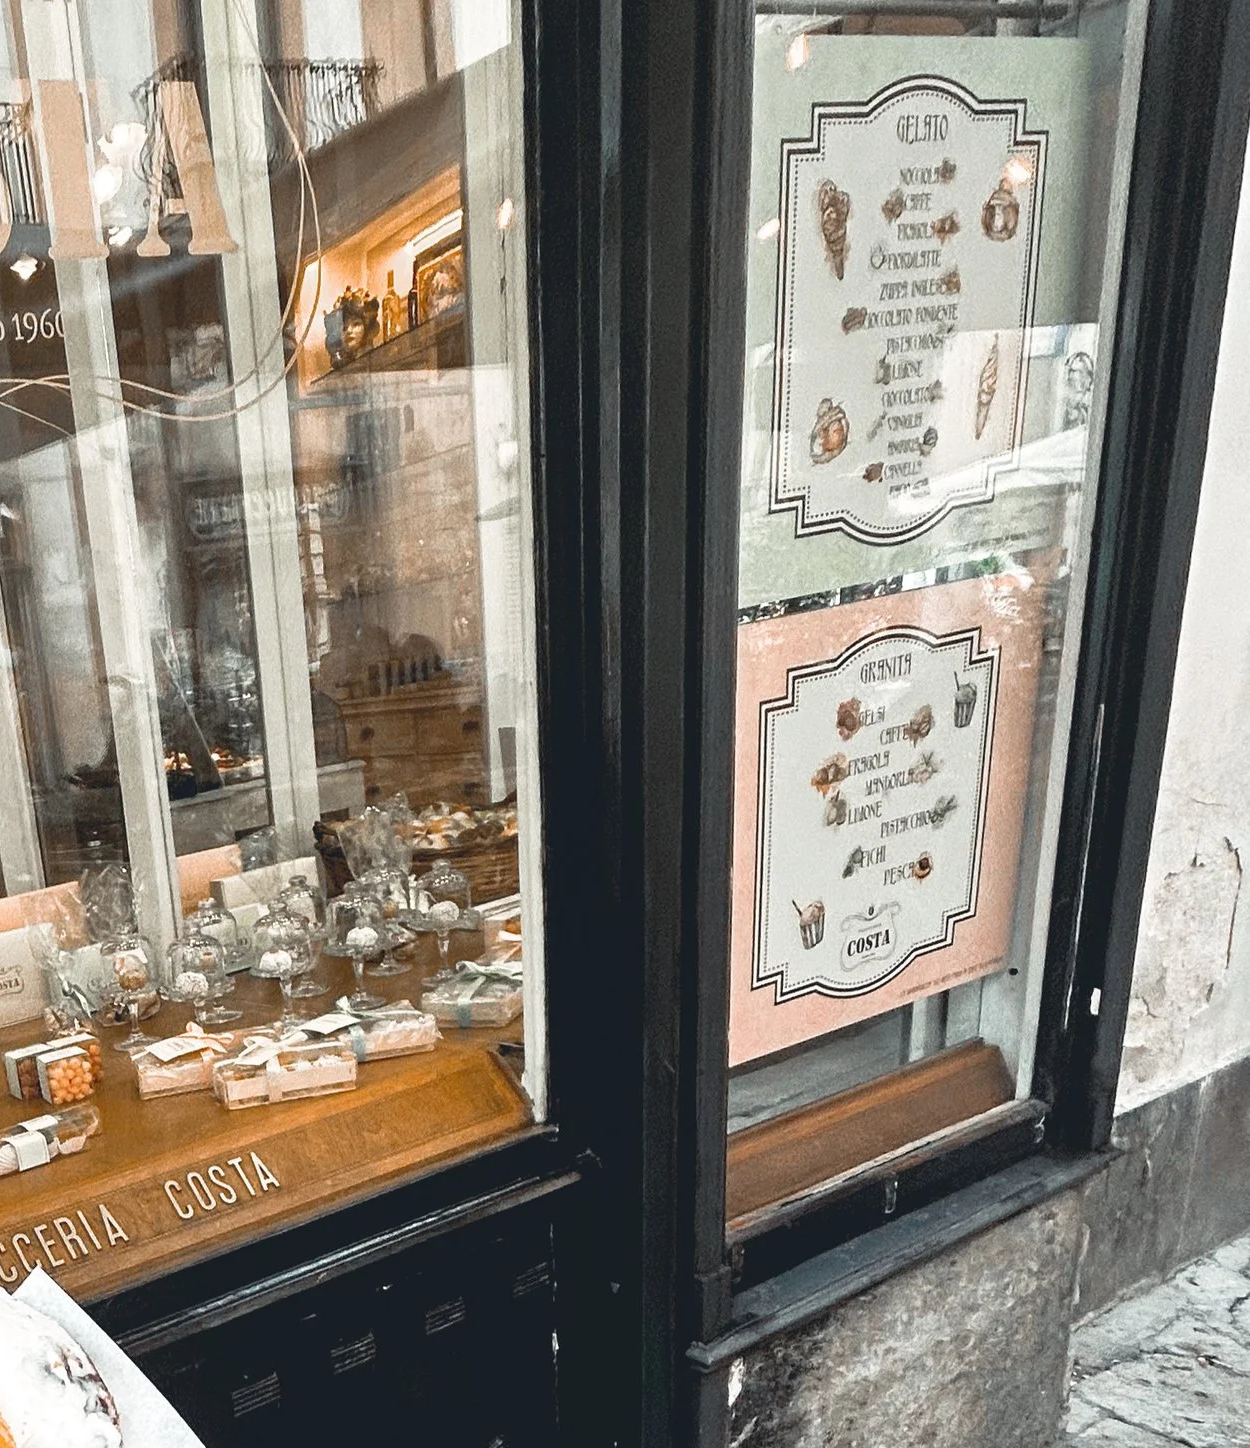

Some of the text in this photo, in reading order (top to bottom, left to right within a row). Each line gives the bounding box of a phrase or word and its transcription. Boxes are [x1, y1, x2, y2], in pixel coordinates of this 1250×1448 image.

[897, 114, 948, 144] GELATO
[12, 308, 65, 343] 1960
[860, 652, 911, 684] GRANITA
[848, 751, 889, 776] FRAGOLA
[848, 801, 882, 825] LIMONE
[880, 810, 932, 838] PISTACCHIO
[860, 846, 886, 868] FICHI
[883, 861, 915, 886] PESCA
[847, 929, 890, 957] COSTA
[164, 1151, 281, 1220] COSTA
